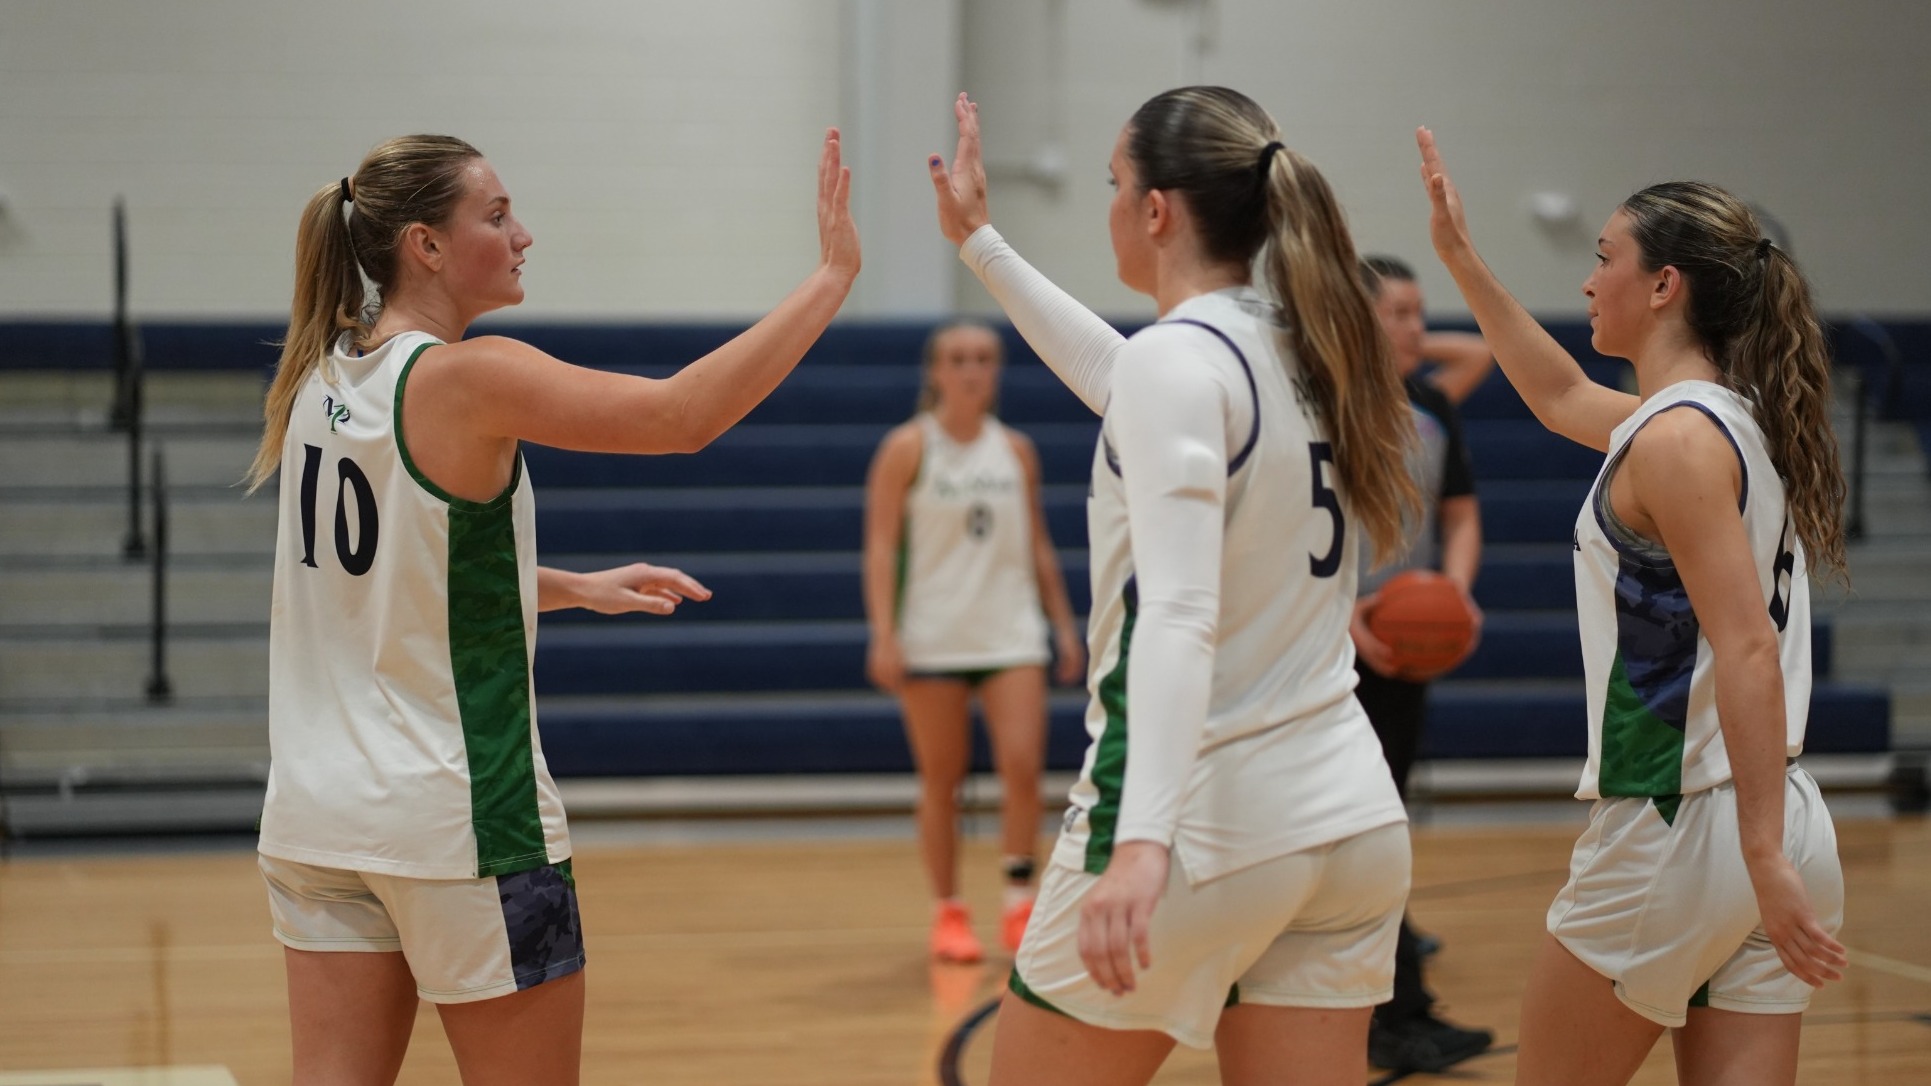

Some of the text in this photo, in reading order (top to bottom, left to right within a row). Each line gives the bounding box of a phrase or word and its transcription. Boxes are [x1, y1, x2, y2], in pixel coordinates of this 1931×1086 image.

[300, 443, 379, 577] 10
[1308, 441, 1346, 578] 5
[1768, 512, 1795, 634] 6
